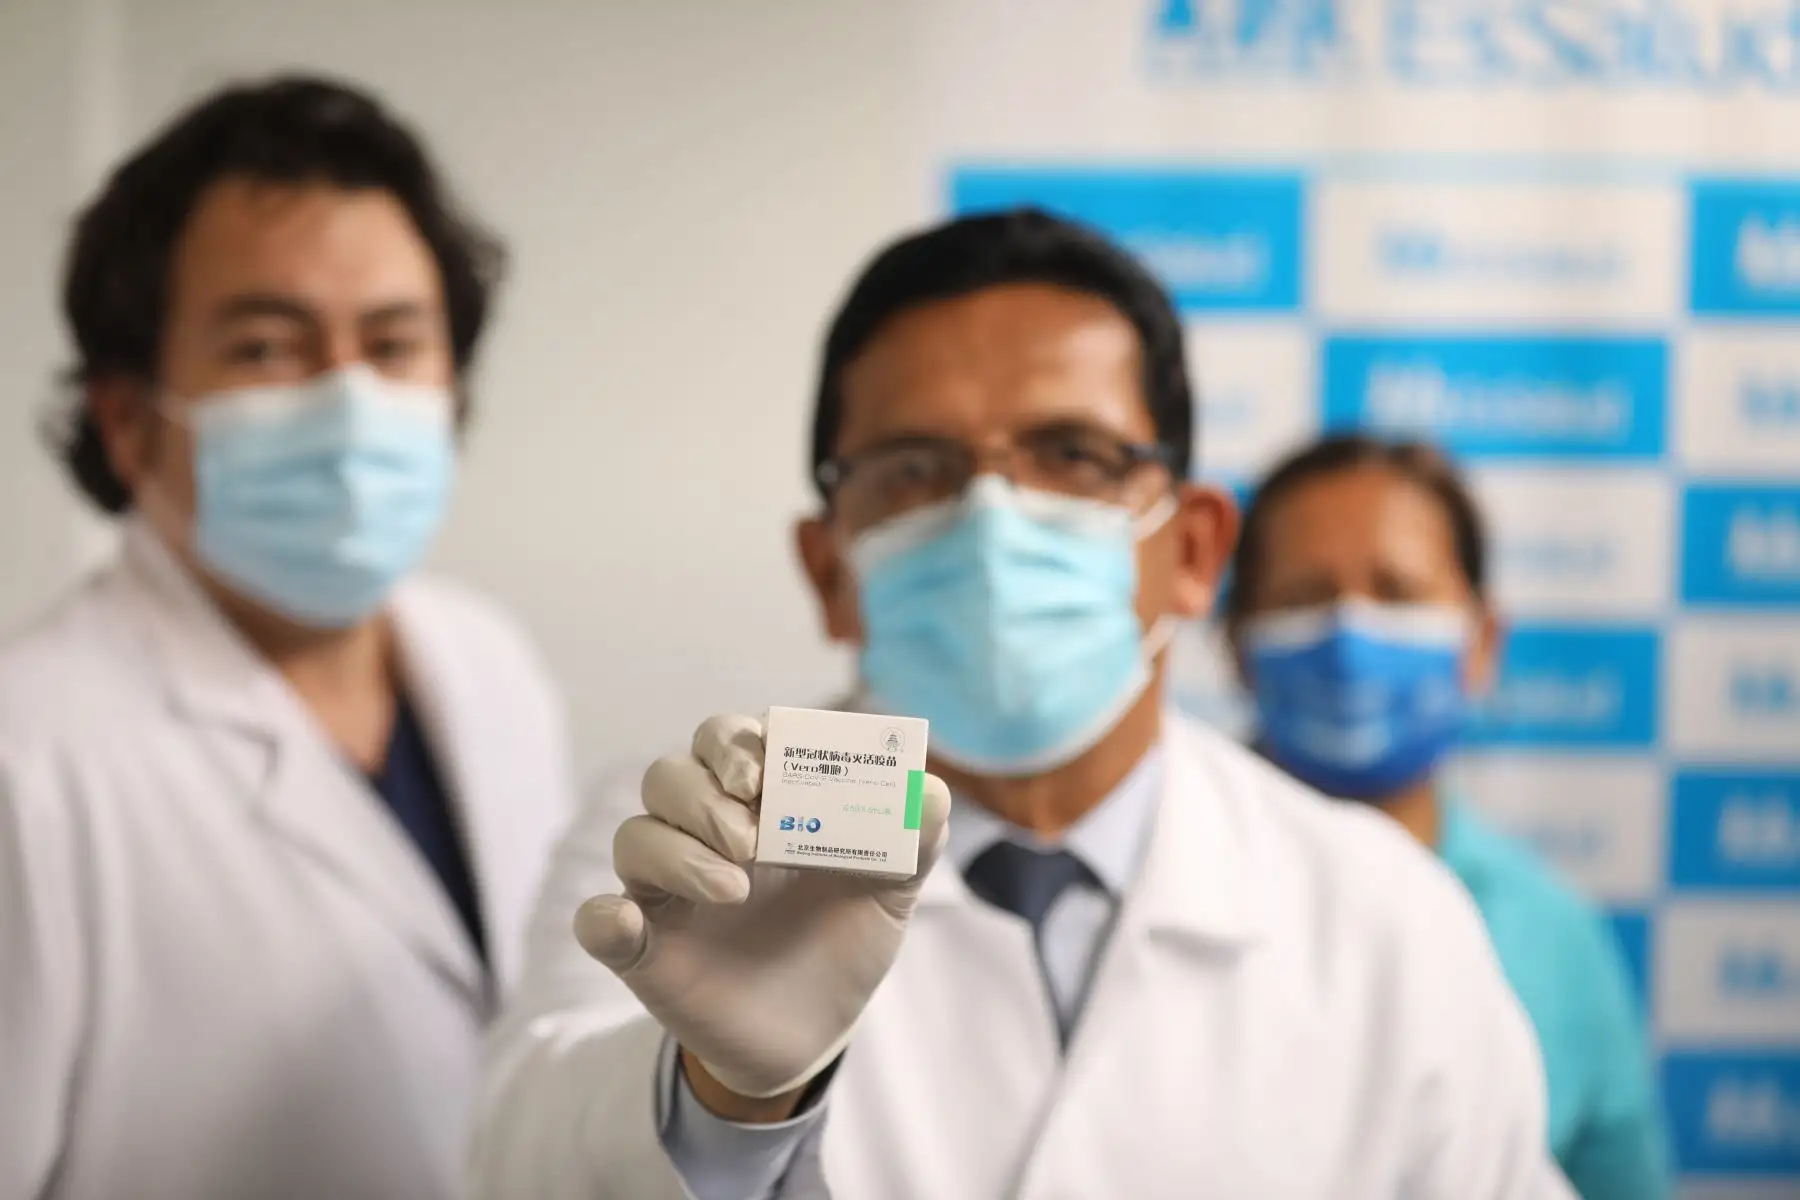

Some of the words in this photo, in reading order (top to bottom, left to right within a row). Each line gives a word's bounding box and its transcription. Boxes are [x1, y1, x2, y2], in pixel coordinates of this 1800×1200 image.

[783, 746, 897, 767] 新型冠状病毒灭活疫苗
[798, 844, 888, 858] 北京生物制品研究所有限责任公司
